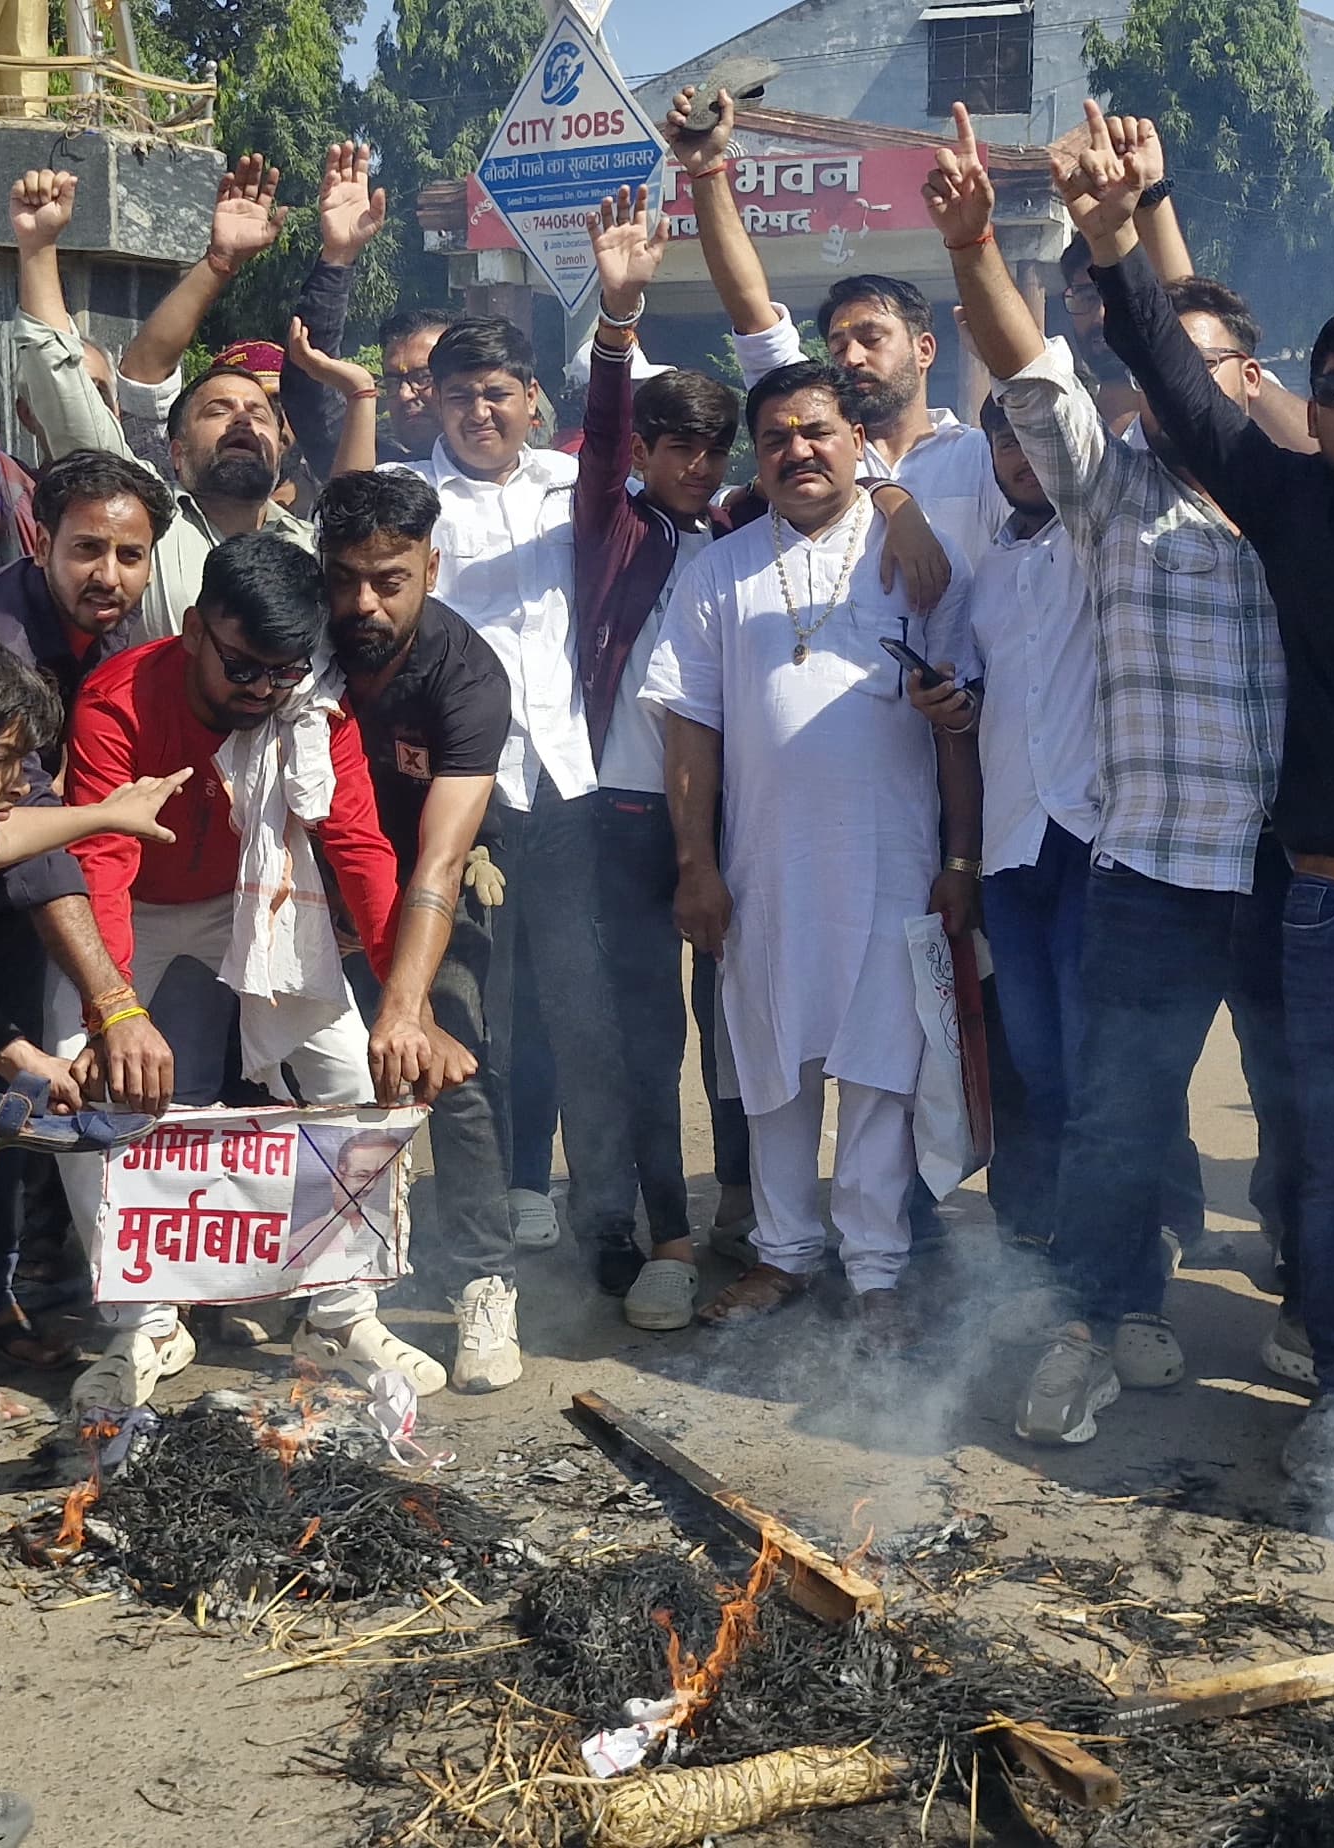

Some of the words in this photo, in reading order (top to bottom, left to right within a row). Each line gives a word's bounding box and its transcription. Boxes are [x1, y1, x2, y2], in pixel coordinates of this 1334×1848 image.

[506, 117, 555, 146] CITY
[561, 109, 624, 140] JOBS
[483, 158, 519, 182] नौकरी
[522, 154, 544, 177] पाने
[547, 157, 565, 174] का
[568, 154, 609, 179] सुनहरा
[613, 150, 655, 168] अवसर
[735, 155, 862, 196] भवन
[555, 254, 586, 266] Damoh
[221, 1118, 296, 1177] बघेल
[116, 1188, 288, 1284] मुर्दाबाद
